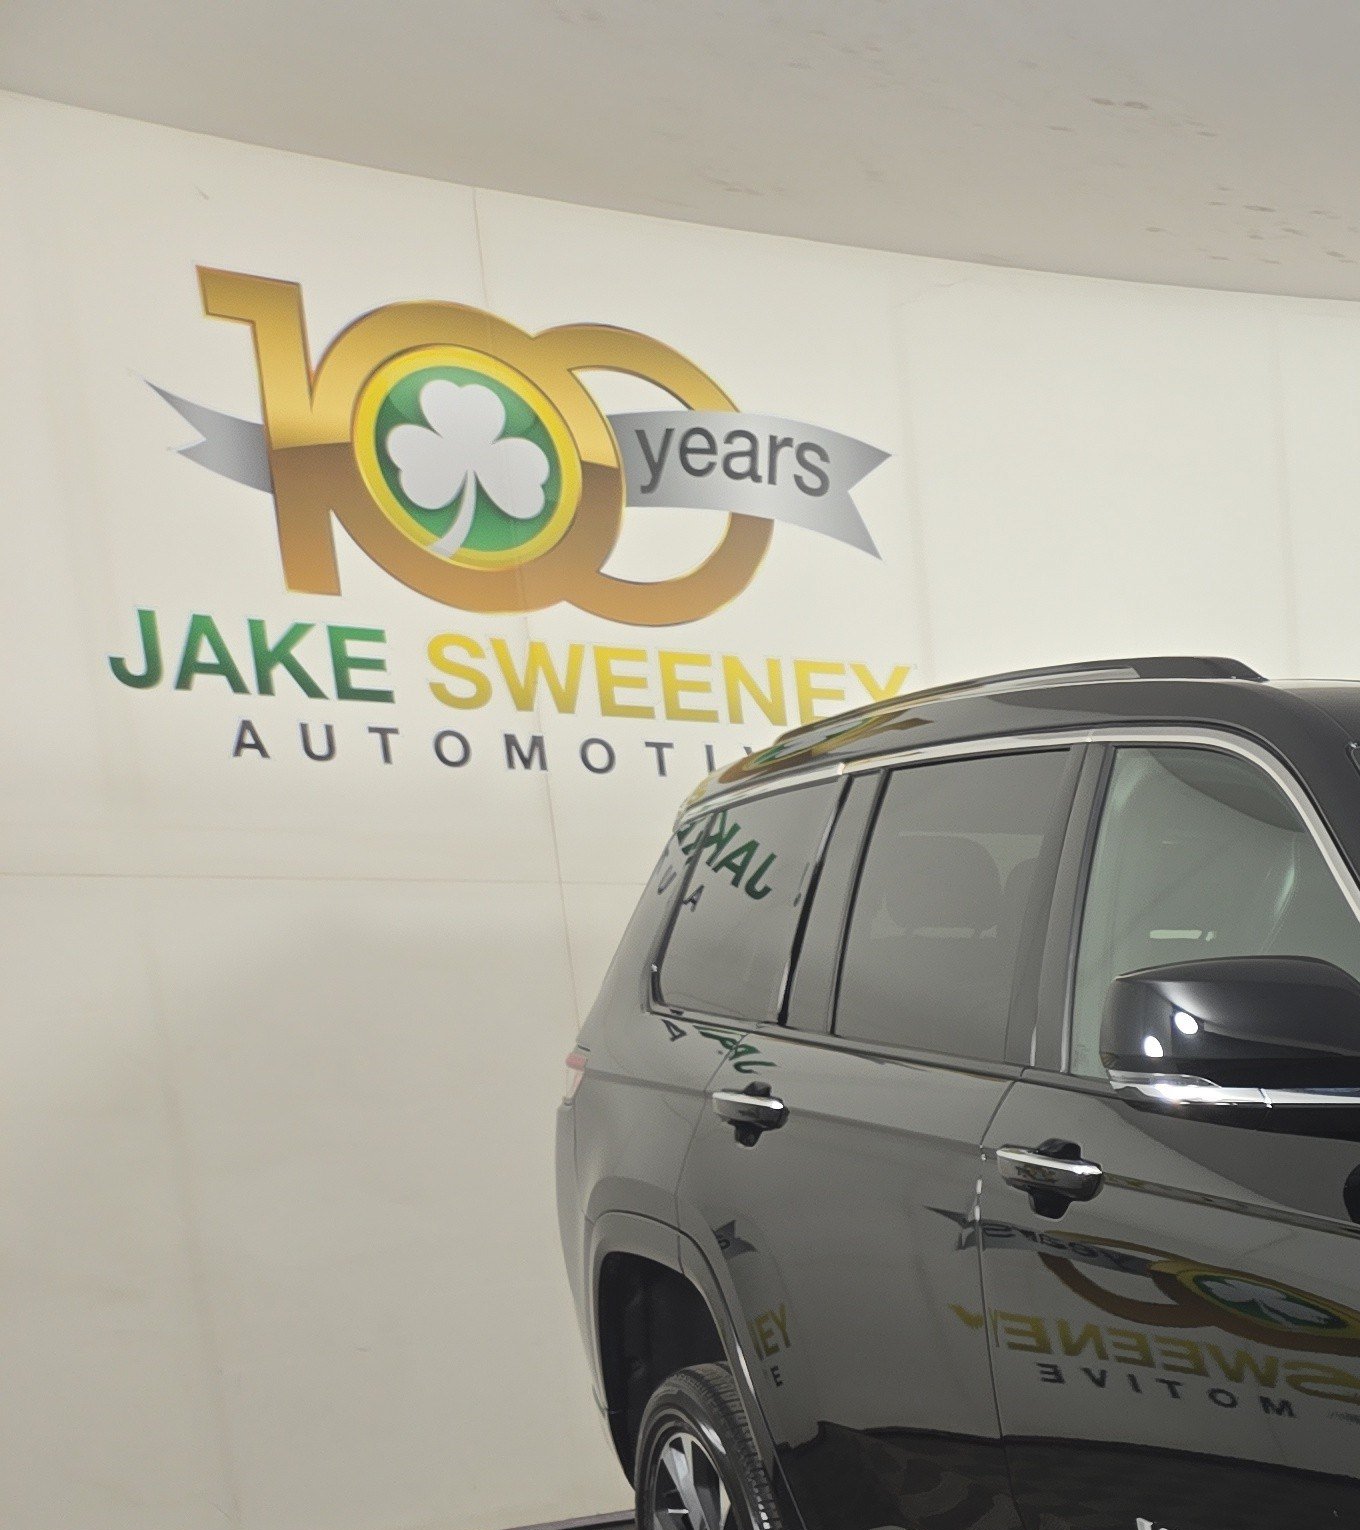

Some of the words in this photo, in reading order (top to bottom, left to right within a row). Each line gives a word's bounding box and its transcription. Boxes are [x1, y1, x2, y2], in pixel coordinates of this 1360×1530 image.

[634, 424, 832, 499] years
[107, 609, 396, 703] JAKE
[427, 633, 911, 727] SWEENEY
[232, 718, 752, 776] AUTOMOTI
